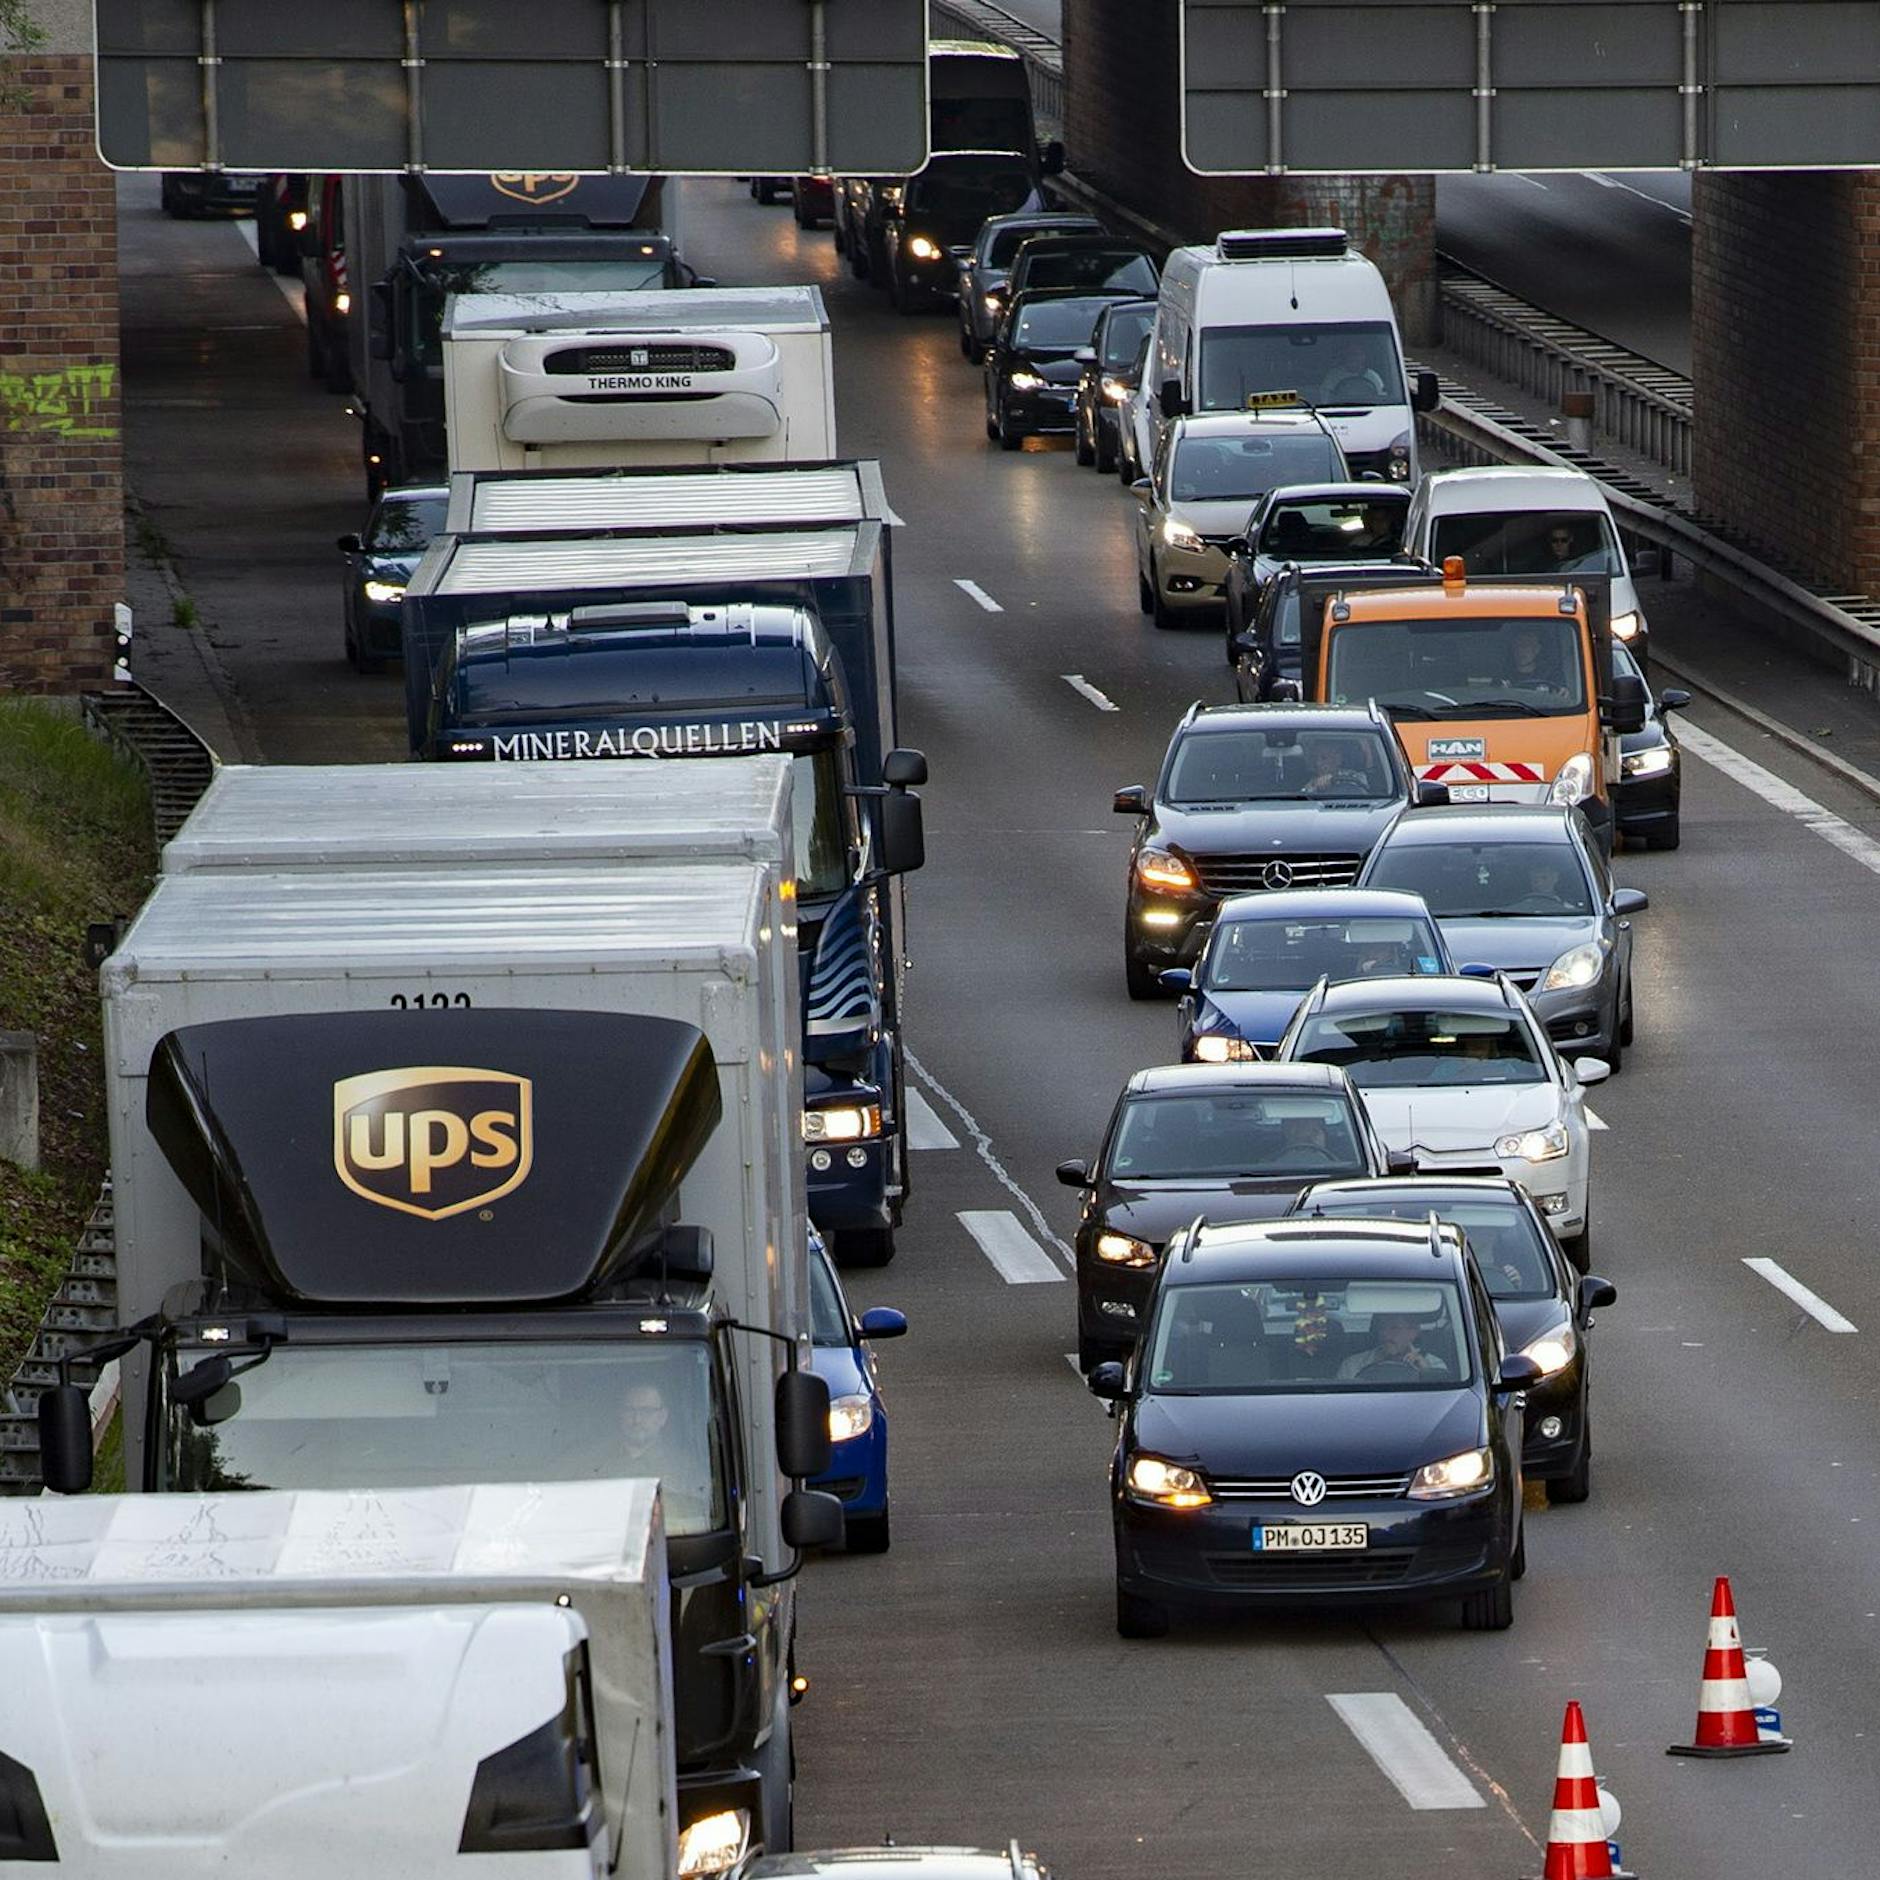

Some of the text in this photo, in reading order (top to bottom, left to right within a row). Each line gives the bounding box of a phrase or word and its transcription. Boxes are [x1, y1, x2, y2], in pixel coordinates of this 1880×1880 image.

[588, 376, 692, 389] THERMO KING
[492, 721, 780, 761] MINERALQUELLEN
[1449, 787, 1488, 800] ECO
[351, 1110, 518, 1193] ups
